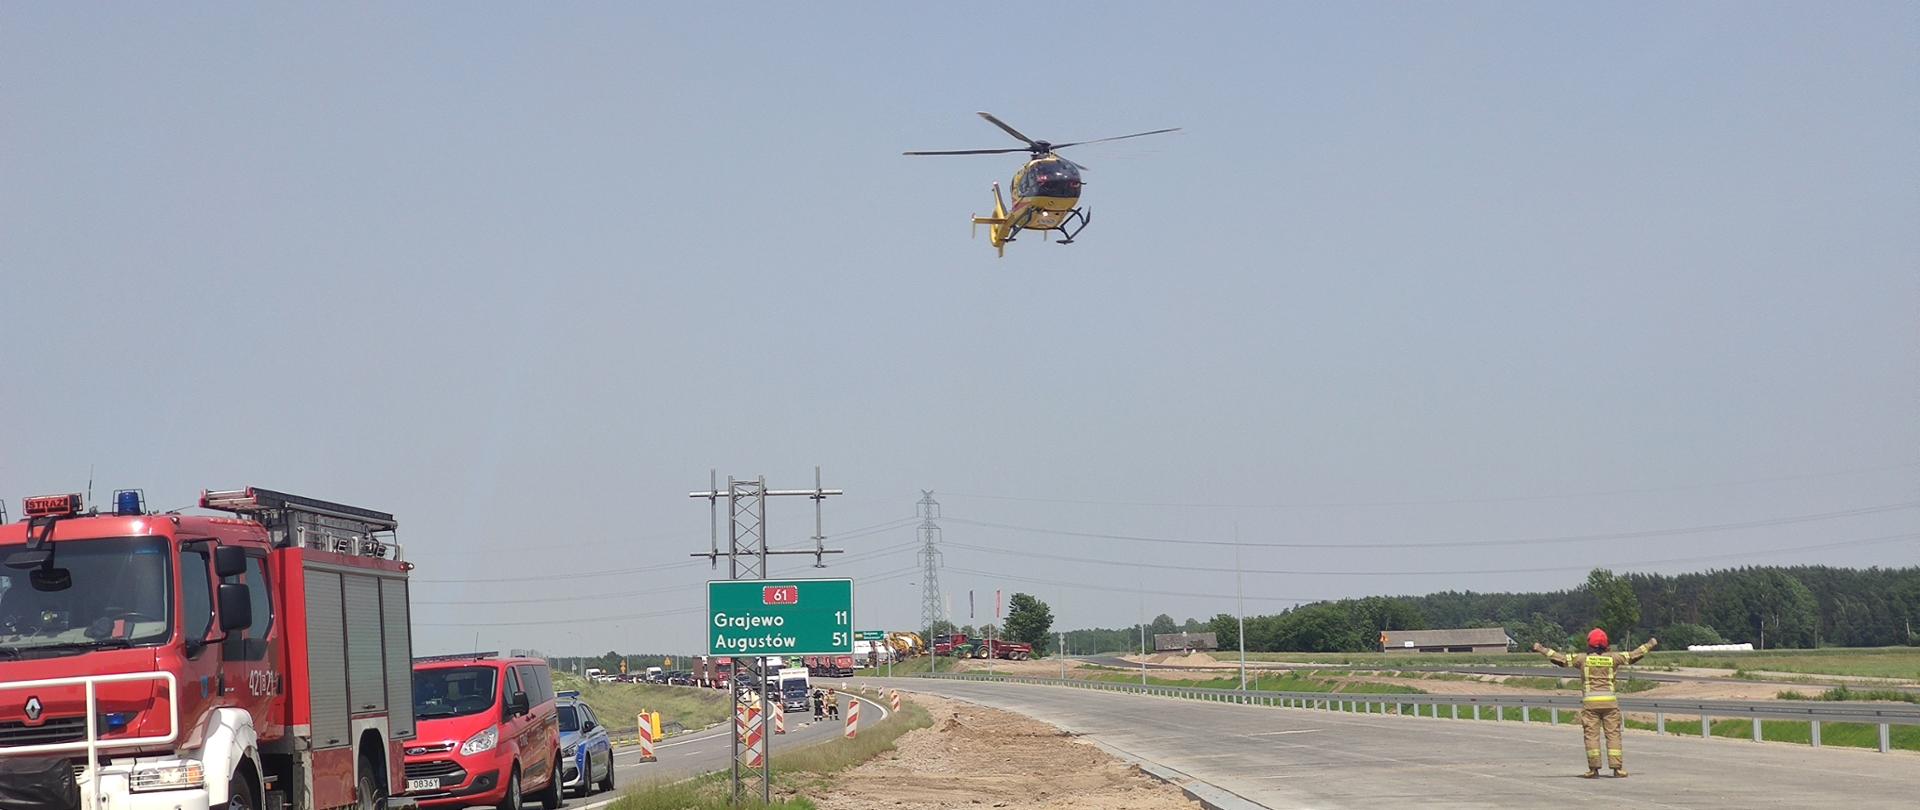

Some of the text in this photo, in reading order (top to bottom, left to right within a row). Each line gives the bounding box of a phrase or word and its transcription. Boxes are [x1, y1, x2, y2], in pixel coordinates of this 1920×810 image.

[773, 589, 787, 601] 61
[714, 611, 847, 631] Grajewo 11
[715, 632, 847, 652] Augustów 51
